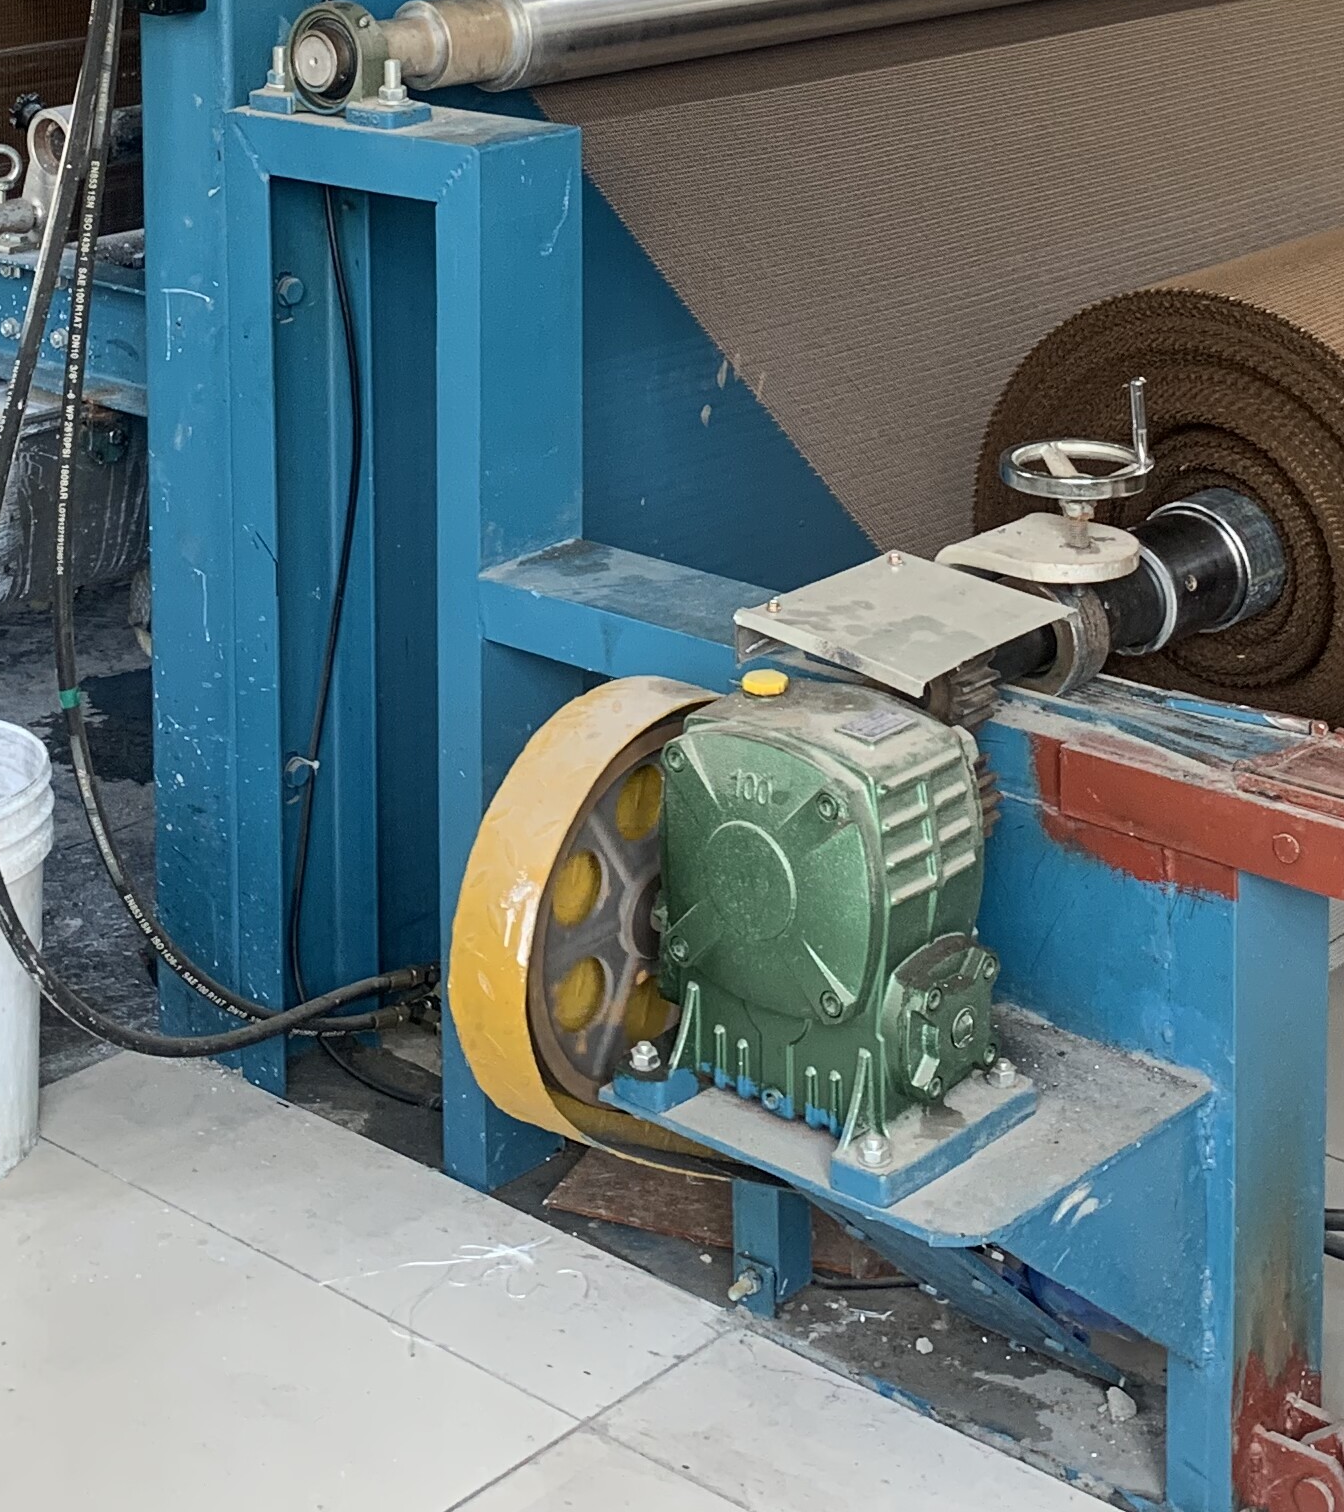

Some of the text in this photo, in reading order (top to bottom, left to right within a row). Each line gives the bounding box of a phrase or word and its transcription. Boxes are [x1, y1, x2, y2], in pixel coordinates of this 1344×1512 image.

[88, 161, 100, 189] EN853
[86, 191, 96, 208] 1SN
[84, 214, 93, 230] ISO
[77, 268, 87, 285] SAE
[76, 288, 85, 303] 100
[73, 305, 84, 328] R1AT
[70, 334, 81, 359] DN10
[65, 405, 75, 420] WP
[62, 422, 73, 457] 2610PSI
[60, 465, 69, 499] 180BAR
[729, 768, 772, 805] 100
[150, 936, 164, 949] ISO
